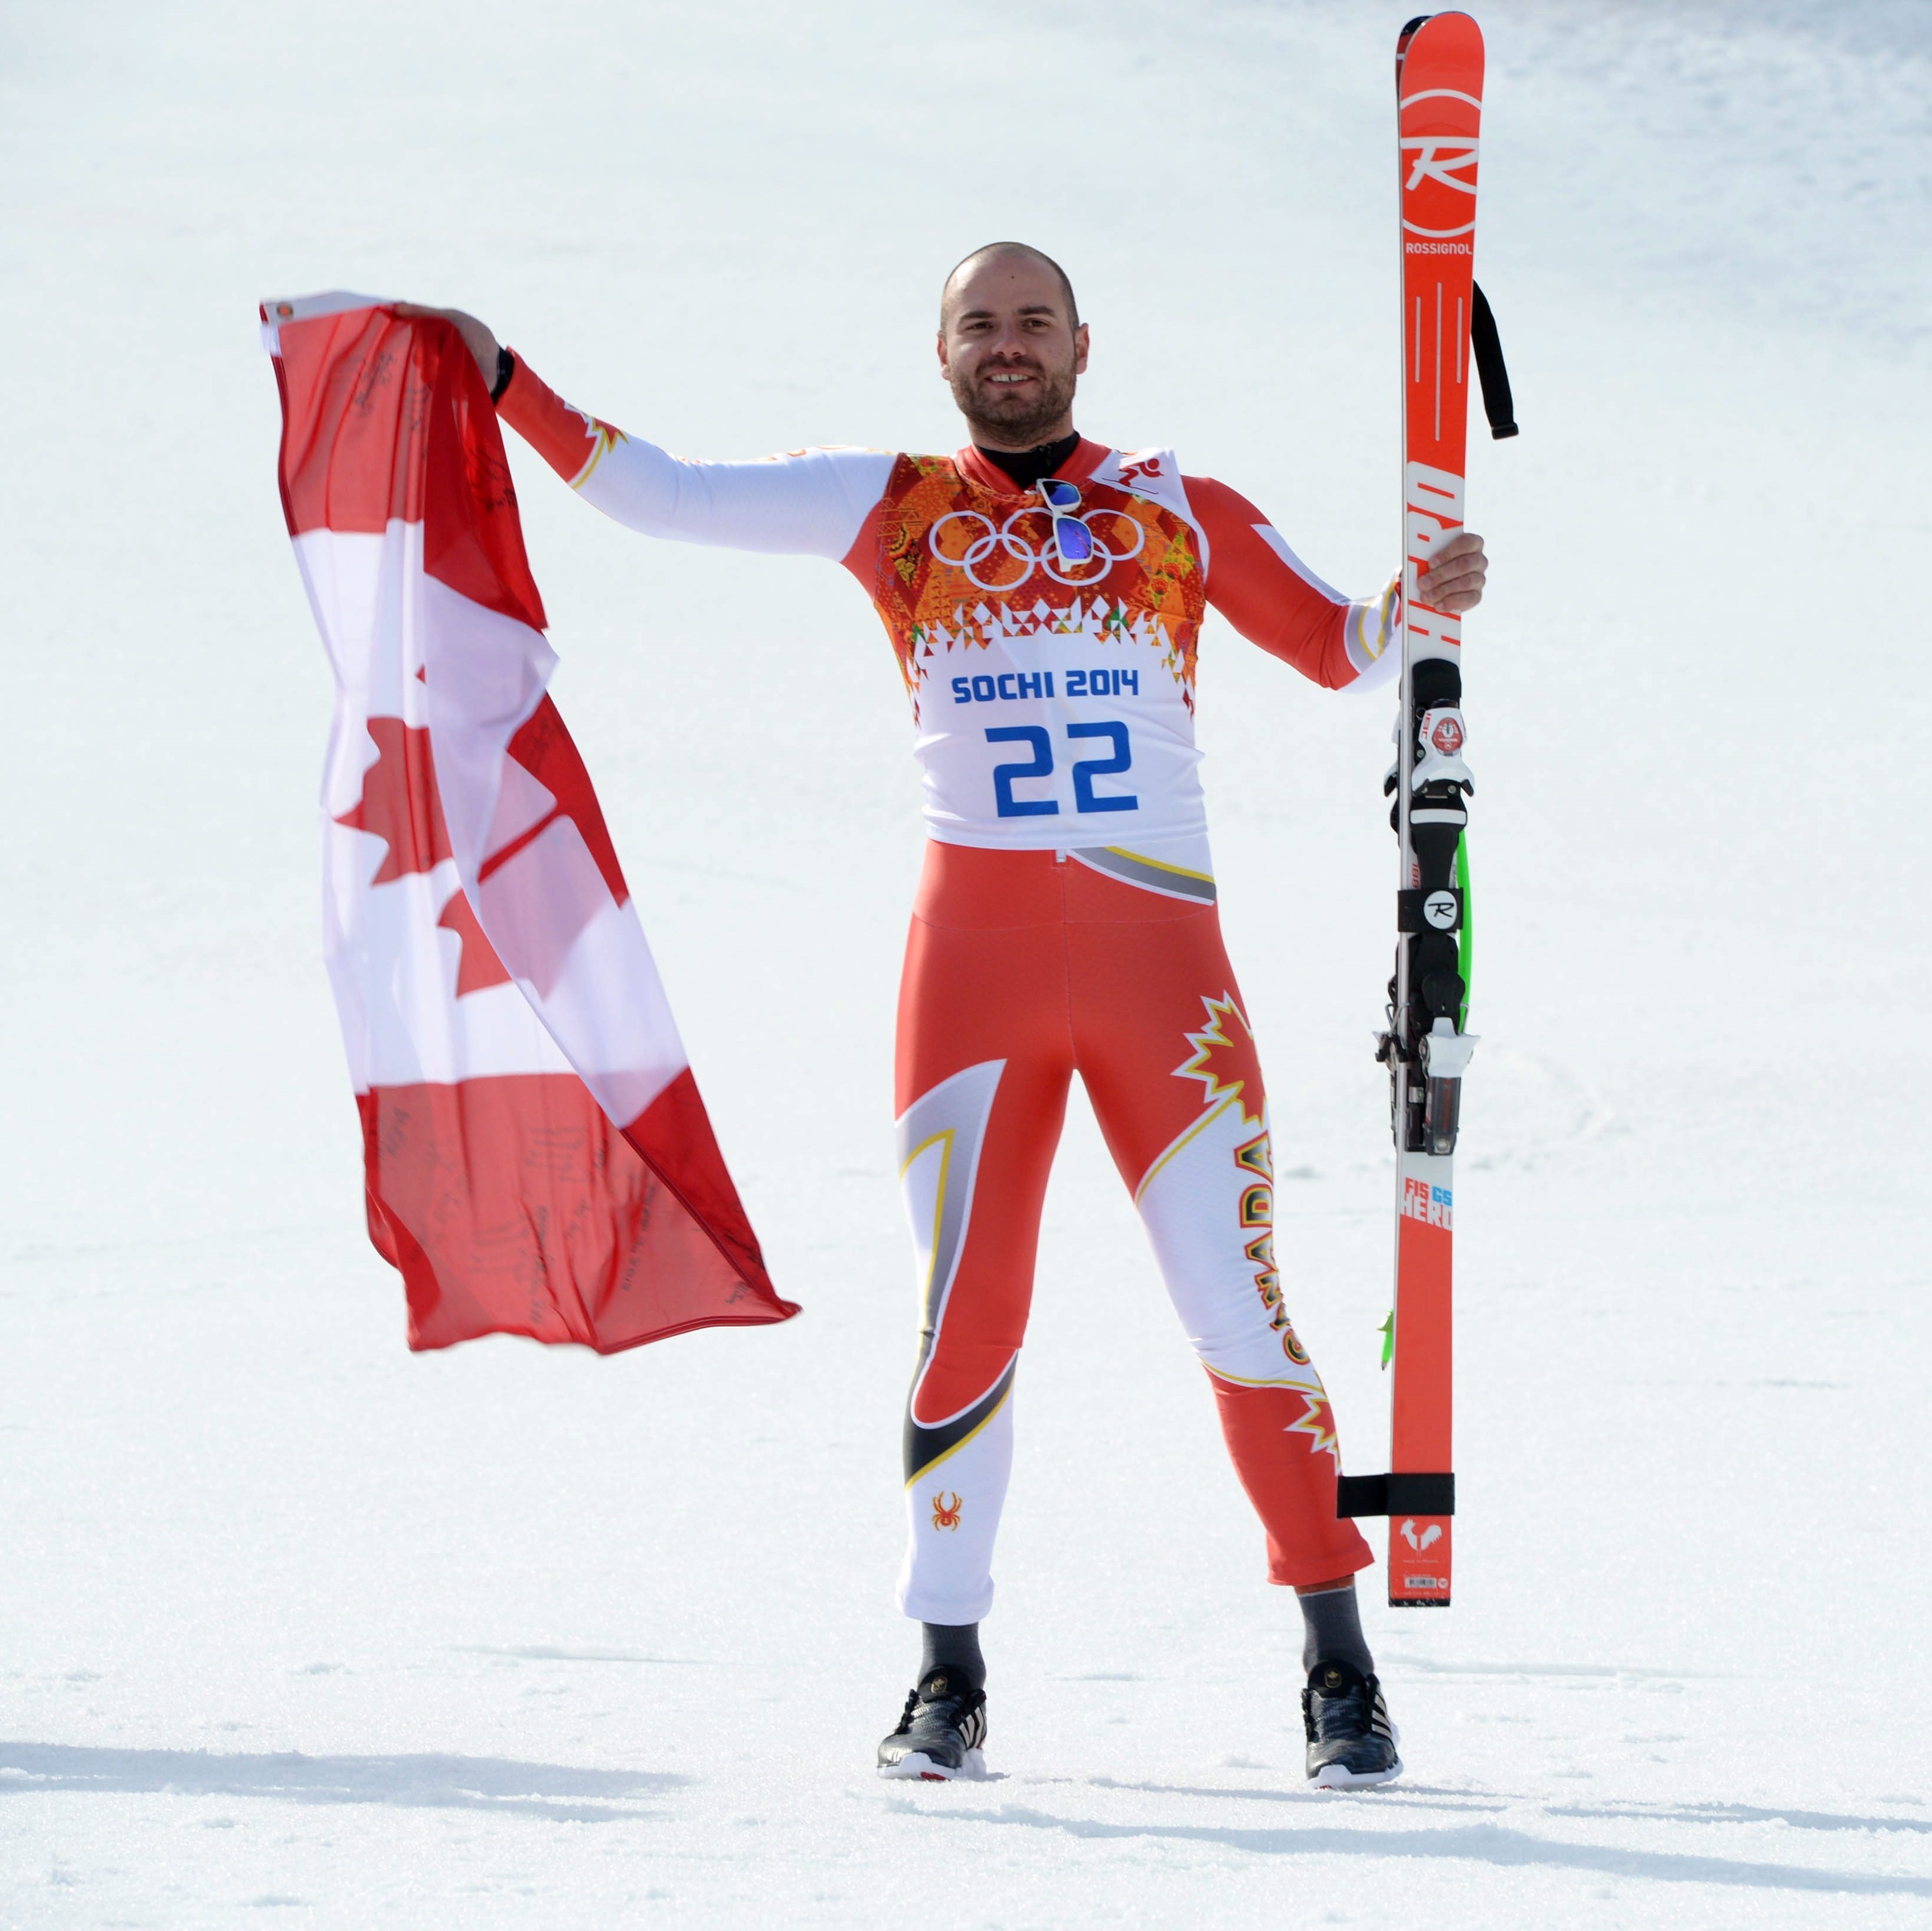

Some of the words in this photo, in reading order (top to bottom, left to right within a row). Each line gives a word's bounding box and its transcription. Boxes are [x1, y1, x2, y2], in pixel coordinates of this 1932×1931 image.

[1405, 242, 1472, 255] ROSSIGNOL
[952, 672, 1054, 704] SOCHI
[1065, 669, 1139, 697] 2014
[984, 721, 1139, 818] 22
[1427, 902, 1454, 918] R
[1405, 1177, 1428, 1200] FIS
[1432, 1185, 1452, 1207] GS
[1401, 1192, 1452, 1231] HERO
